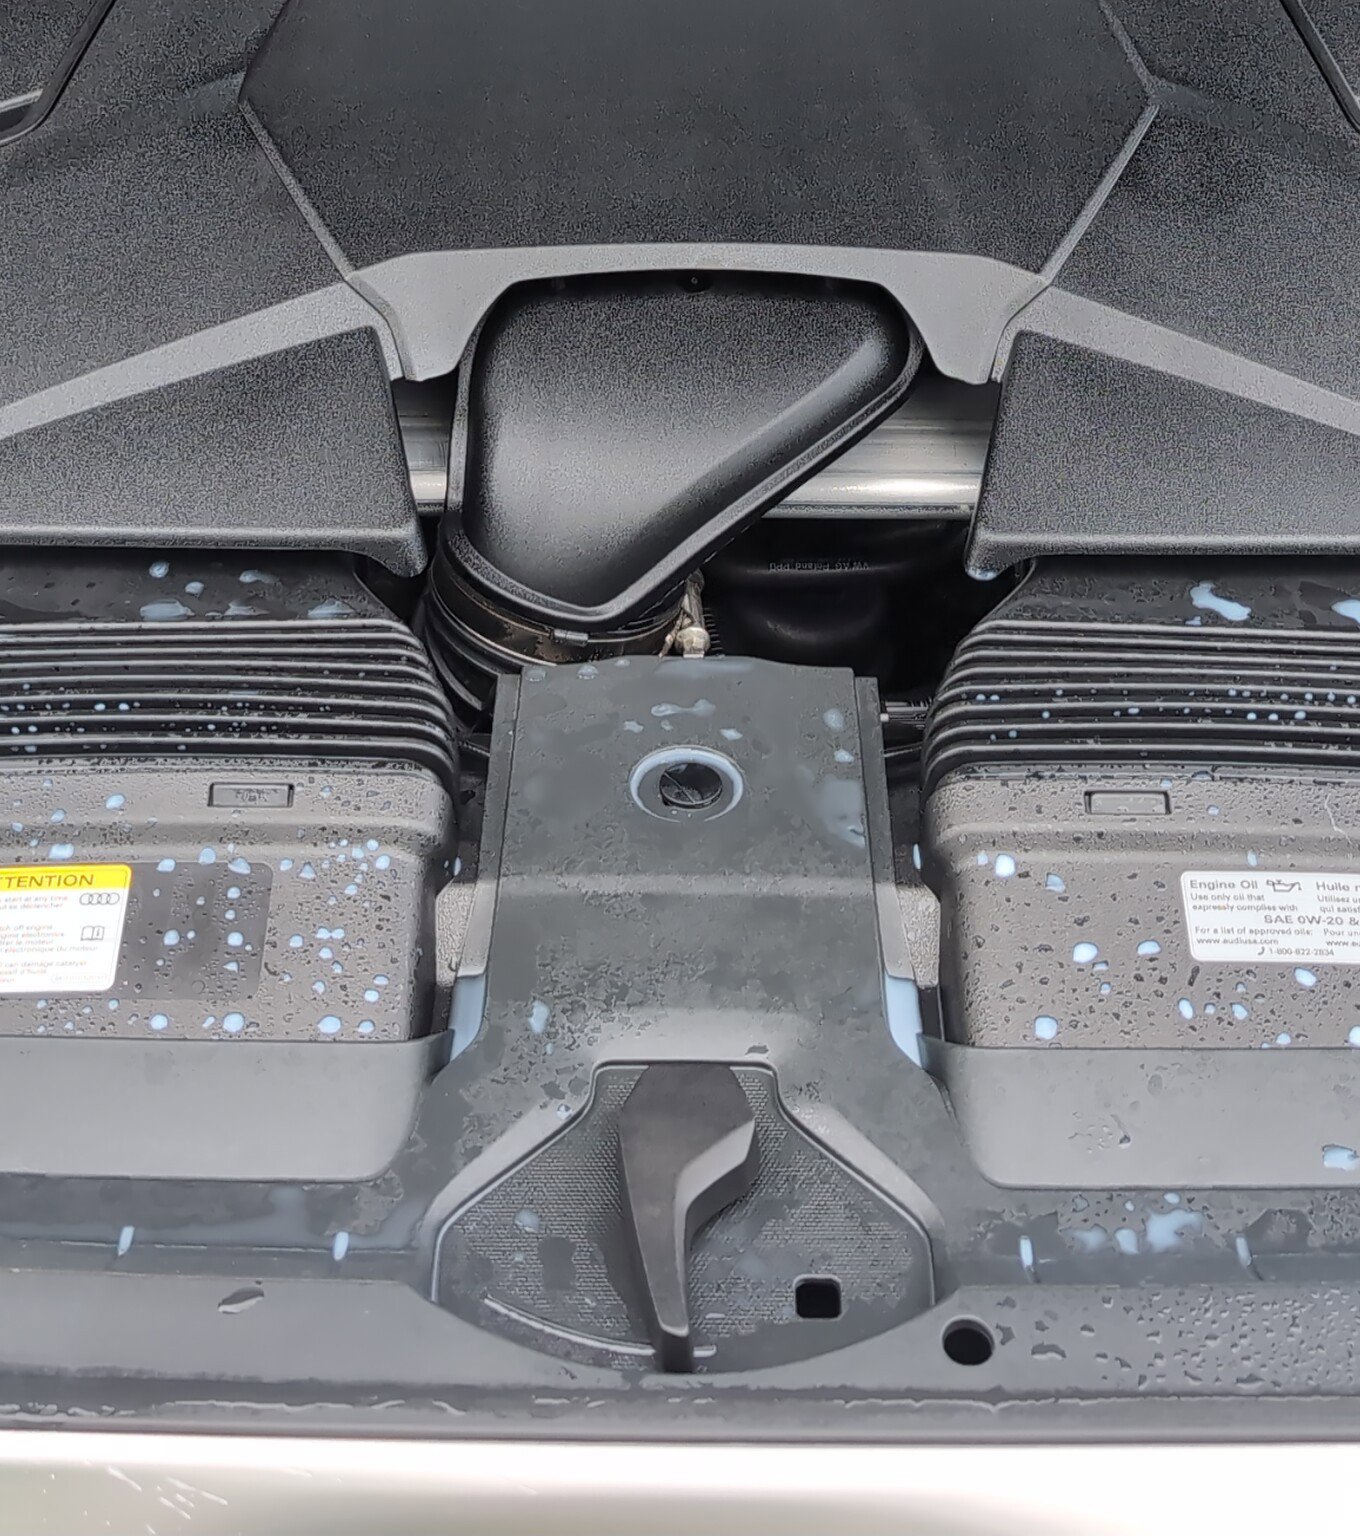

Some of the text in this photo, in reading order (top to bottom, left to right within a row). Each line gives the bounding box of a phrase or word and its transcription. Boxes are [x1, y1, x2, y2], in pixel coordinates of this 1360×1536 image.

[1190, 880, 1258, 890] Engine Oil
[1316, 882, 1350, 891] Huile
[1190, 893, 1208, 901] Use
[1211, 893, 1231, 902] only
[1192, 904, 1234, 912] expressly
[1237, 904, 1276, 912] complies
[1320, 906, 1334, 914] qui
[1264, 915, 1293, 924] SAE
[1297, 915, 1344, 925] 0W-20
[1349, 917, 1359, 925] &
[1195, 926, 1210, 934] For
[1221, 926, 1234, 934] list
[1237, 926, 1246, 934] of
[1249, 927, 1292, 936] approved
[1196, 937, 1279, 945] www.audiusa.com
